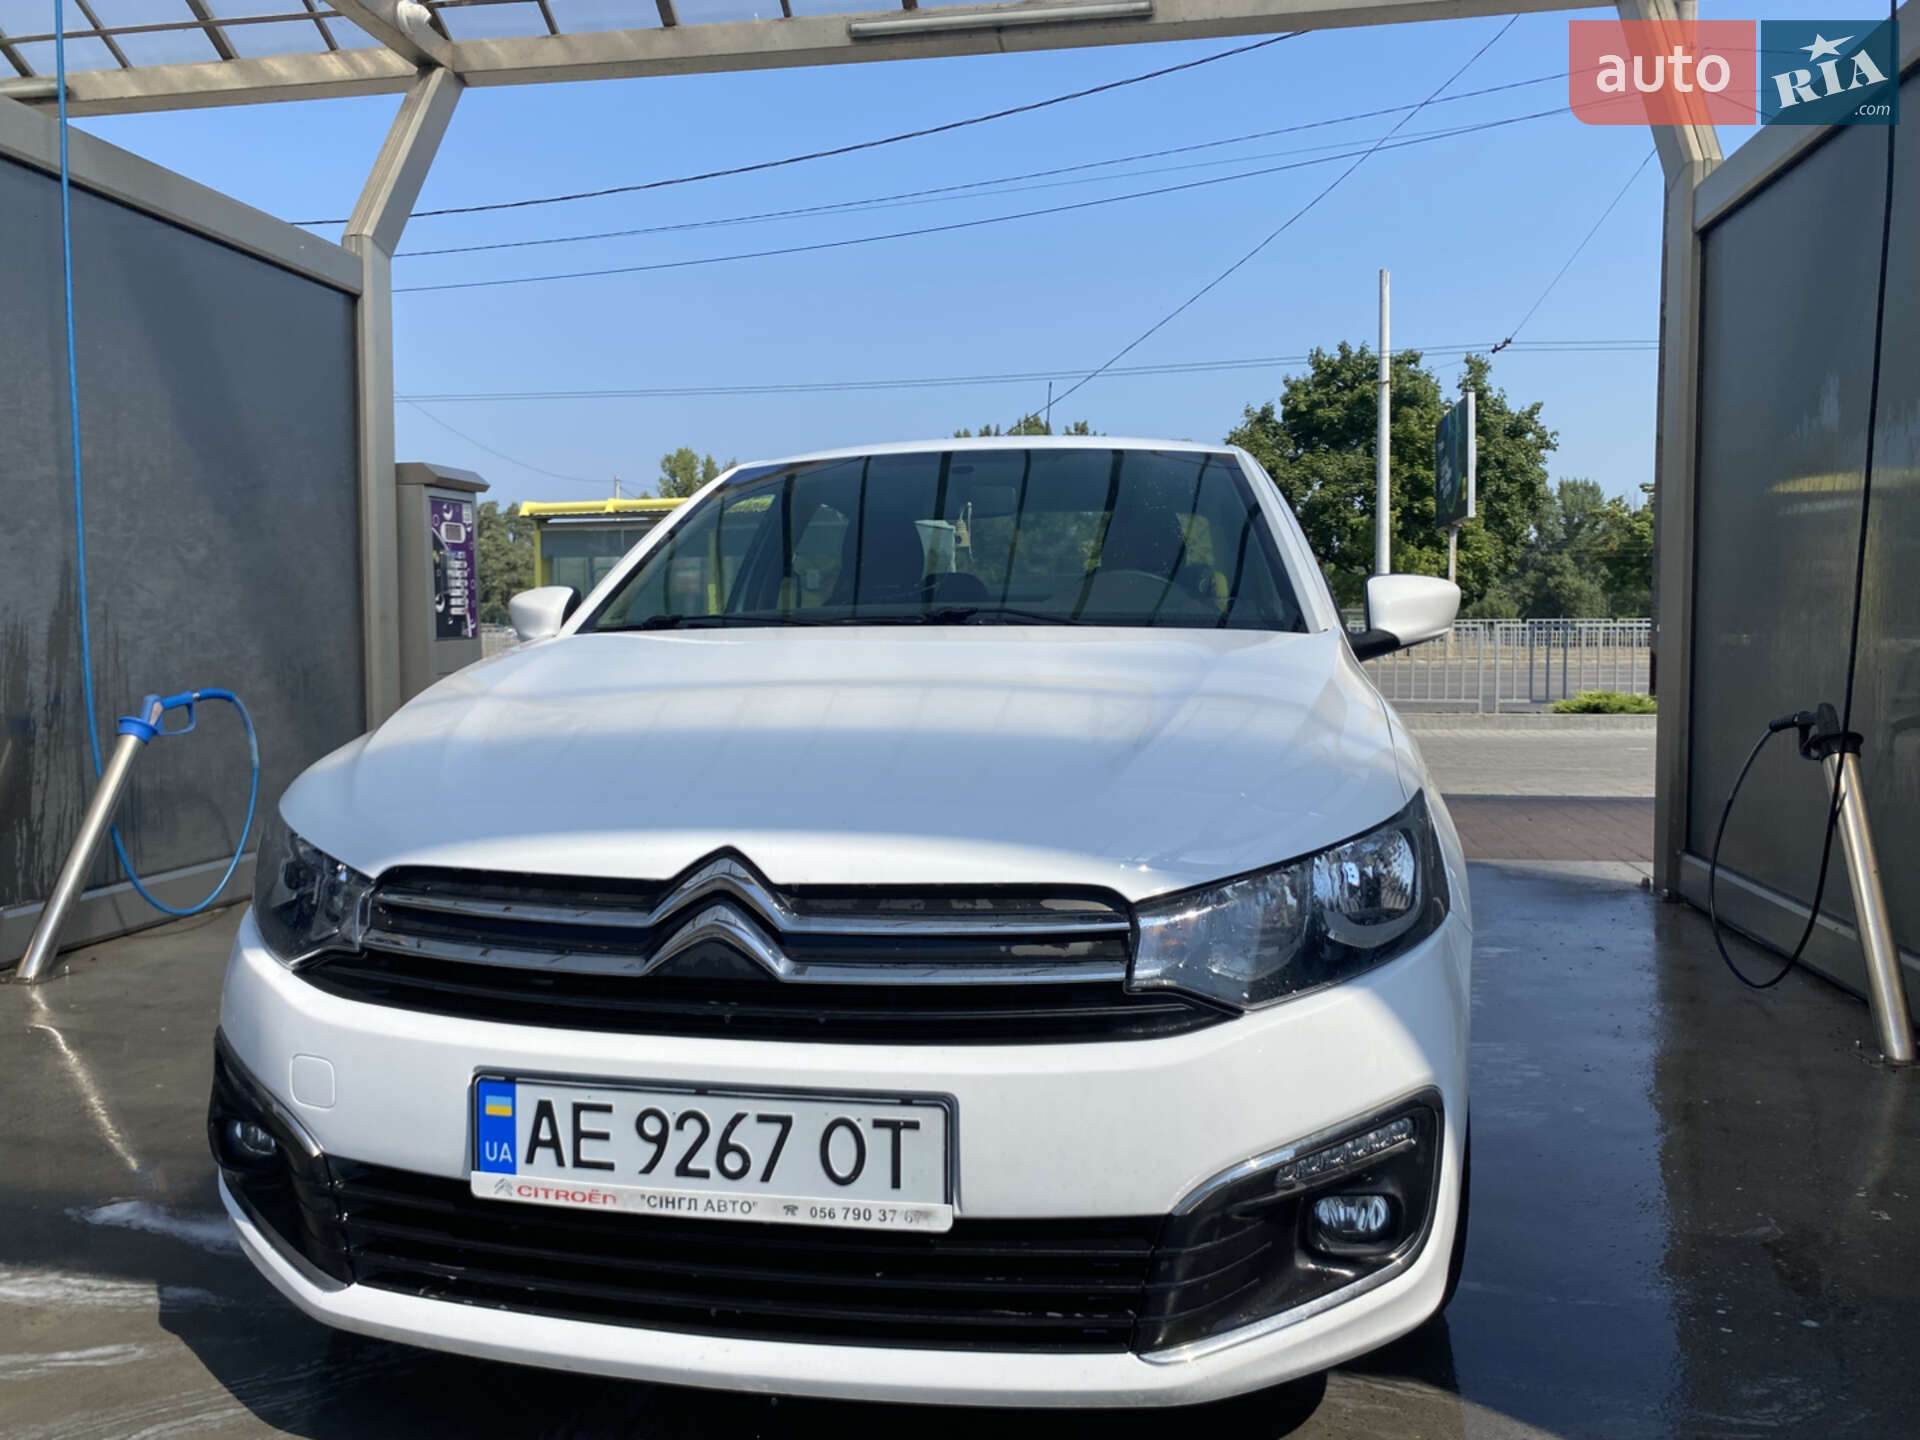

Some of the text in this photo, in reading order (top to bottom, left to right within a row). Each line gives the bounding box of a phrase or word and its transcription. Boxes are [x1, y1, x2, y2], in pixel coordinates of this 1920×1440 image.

[485, 1141, 512, 1162] UA
[525, 1099, 921, 1189] AE 9267 OT
[810, 1206, 836, 1219] 056
[842, 1207, 872, 1222] 790
[878, 1209, 897, 1222] 37
